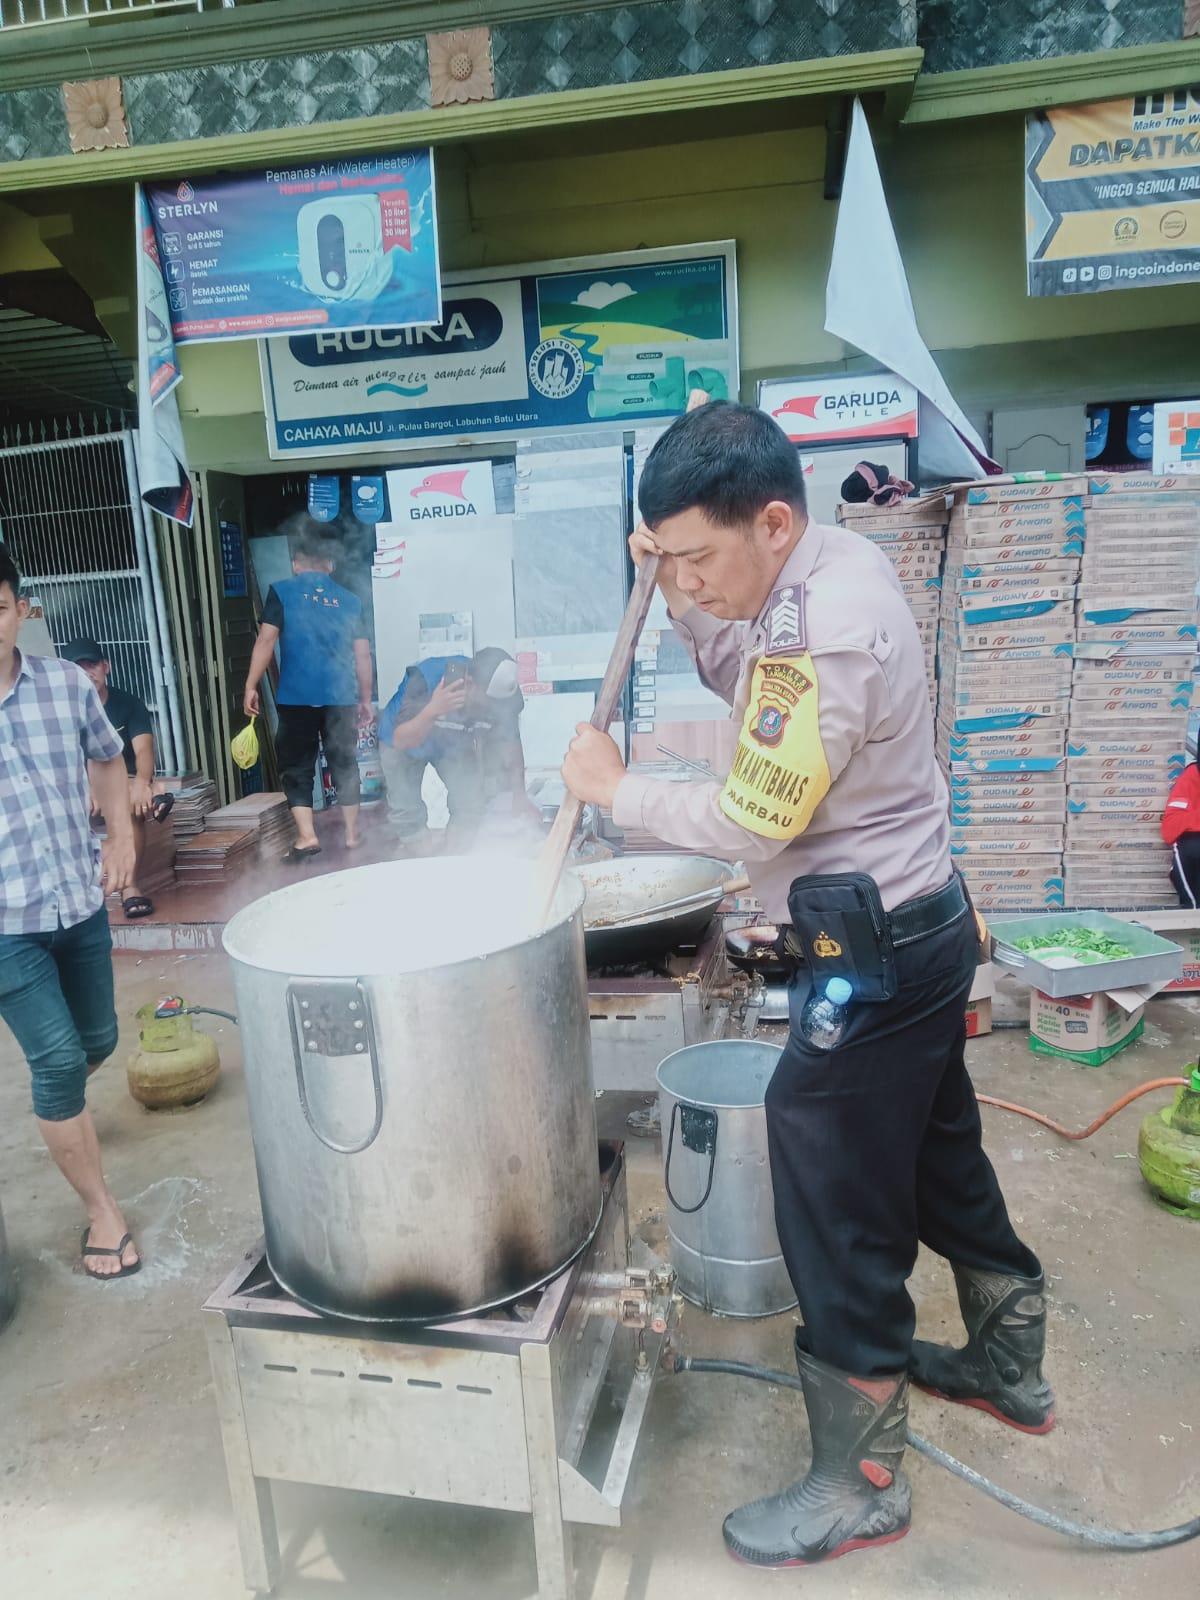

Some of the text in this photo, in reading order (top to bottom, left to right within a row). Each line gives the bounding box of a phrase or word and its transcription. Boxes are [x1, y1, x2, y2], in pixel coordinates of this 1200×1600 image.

[1134, 120, 1161, 131] Make
[1166, 116, 1185, 126] The
[266, 154, 416, 183] Pemanas Air (Water Heater)
[1136, 178, 1176, 195] SEMUA
[158, 201, 218, 219] STERLYN
[187, 229, 224, 241] GARANSI
[189, 259, 218, 270] HEMAT
[192, 283, 250, 297] PEMASANGAN
[316, 312, 475, 355] RUCIKA
[531, 340, 582, 367] SOLUSI TOTAL
[293, 360, 506, 393] Dimana air mengalir sampai jauh
[824, 390, 902, 410] GARUDA
[836, 407, 889, 420] TILE
[284, 423, 341, 443] CAHAYA
[344, 420, 384, 437] MAJU
[398, 422, 422, 432] Pulau
[456, 416, 492, 428] Labuhan
[494, 414, 514, 425] Batu
[516, 411, 539, 422] Utara
[409, 502, 477, 521] GARUDA
[1055, 1006, 1070, 1016] 40
